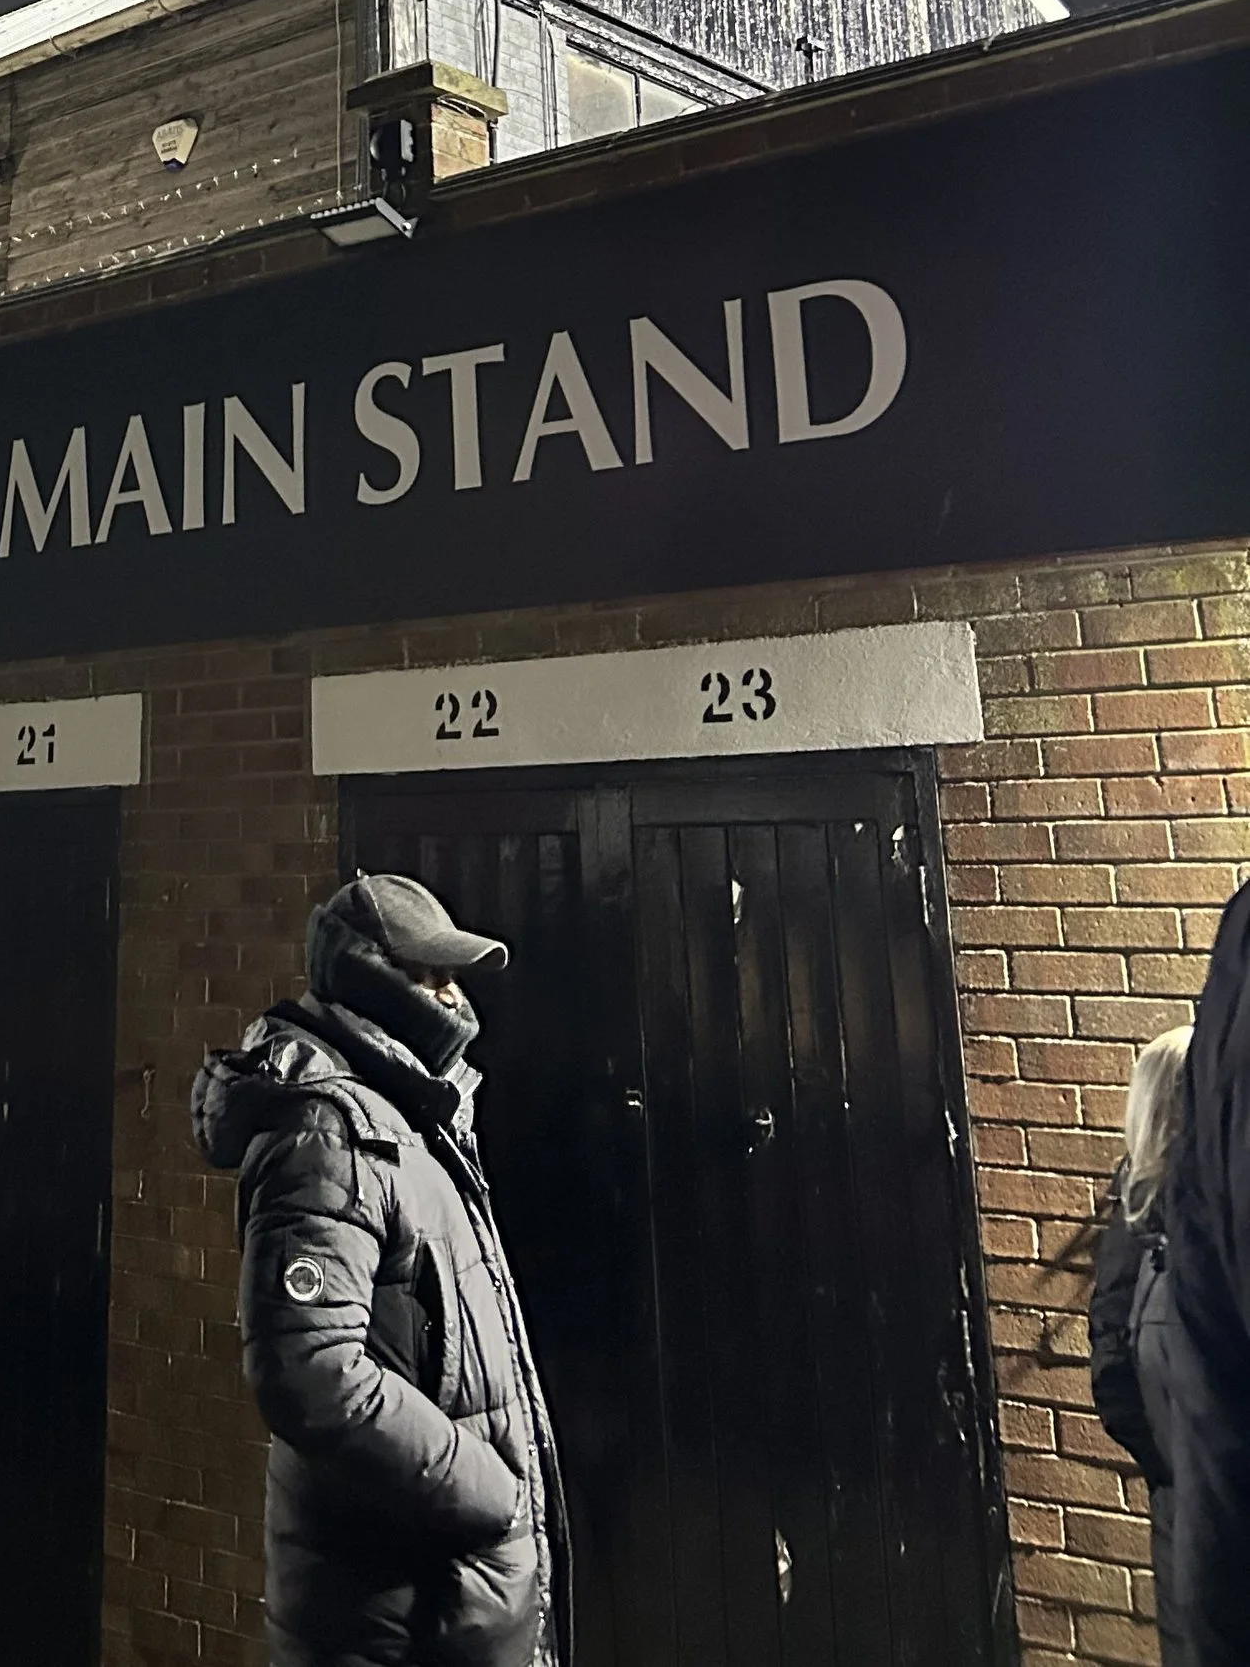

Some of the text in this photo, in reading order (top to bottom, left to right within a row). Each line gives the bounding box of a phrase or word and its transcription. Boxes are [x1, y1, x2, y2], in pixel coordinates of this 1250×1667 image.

[354, 278, 907, 506] STAND
[435, 689, 500, 740] 22
[700, 668, 777, 724] 23
[16, 724, 56, 766] 21
